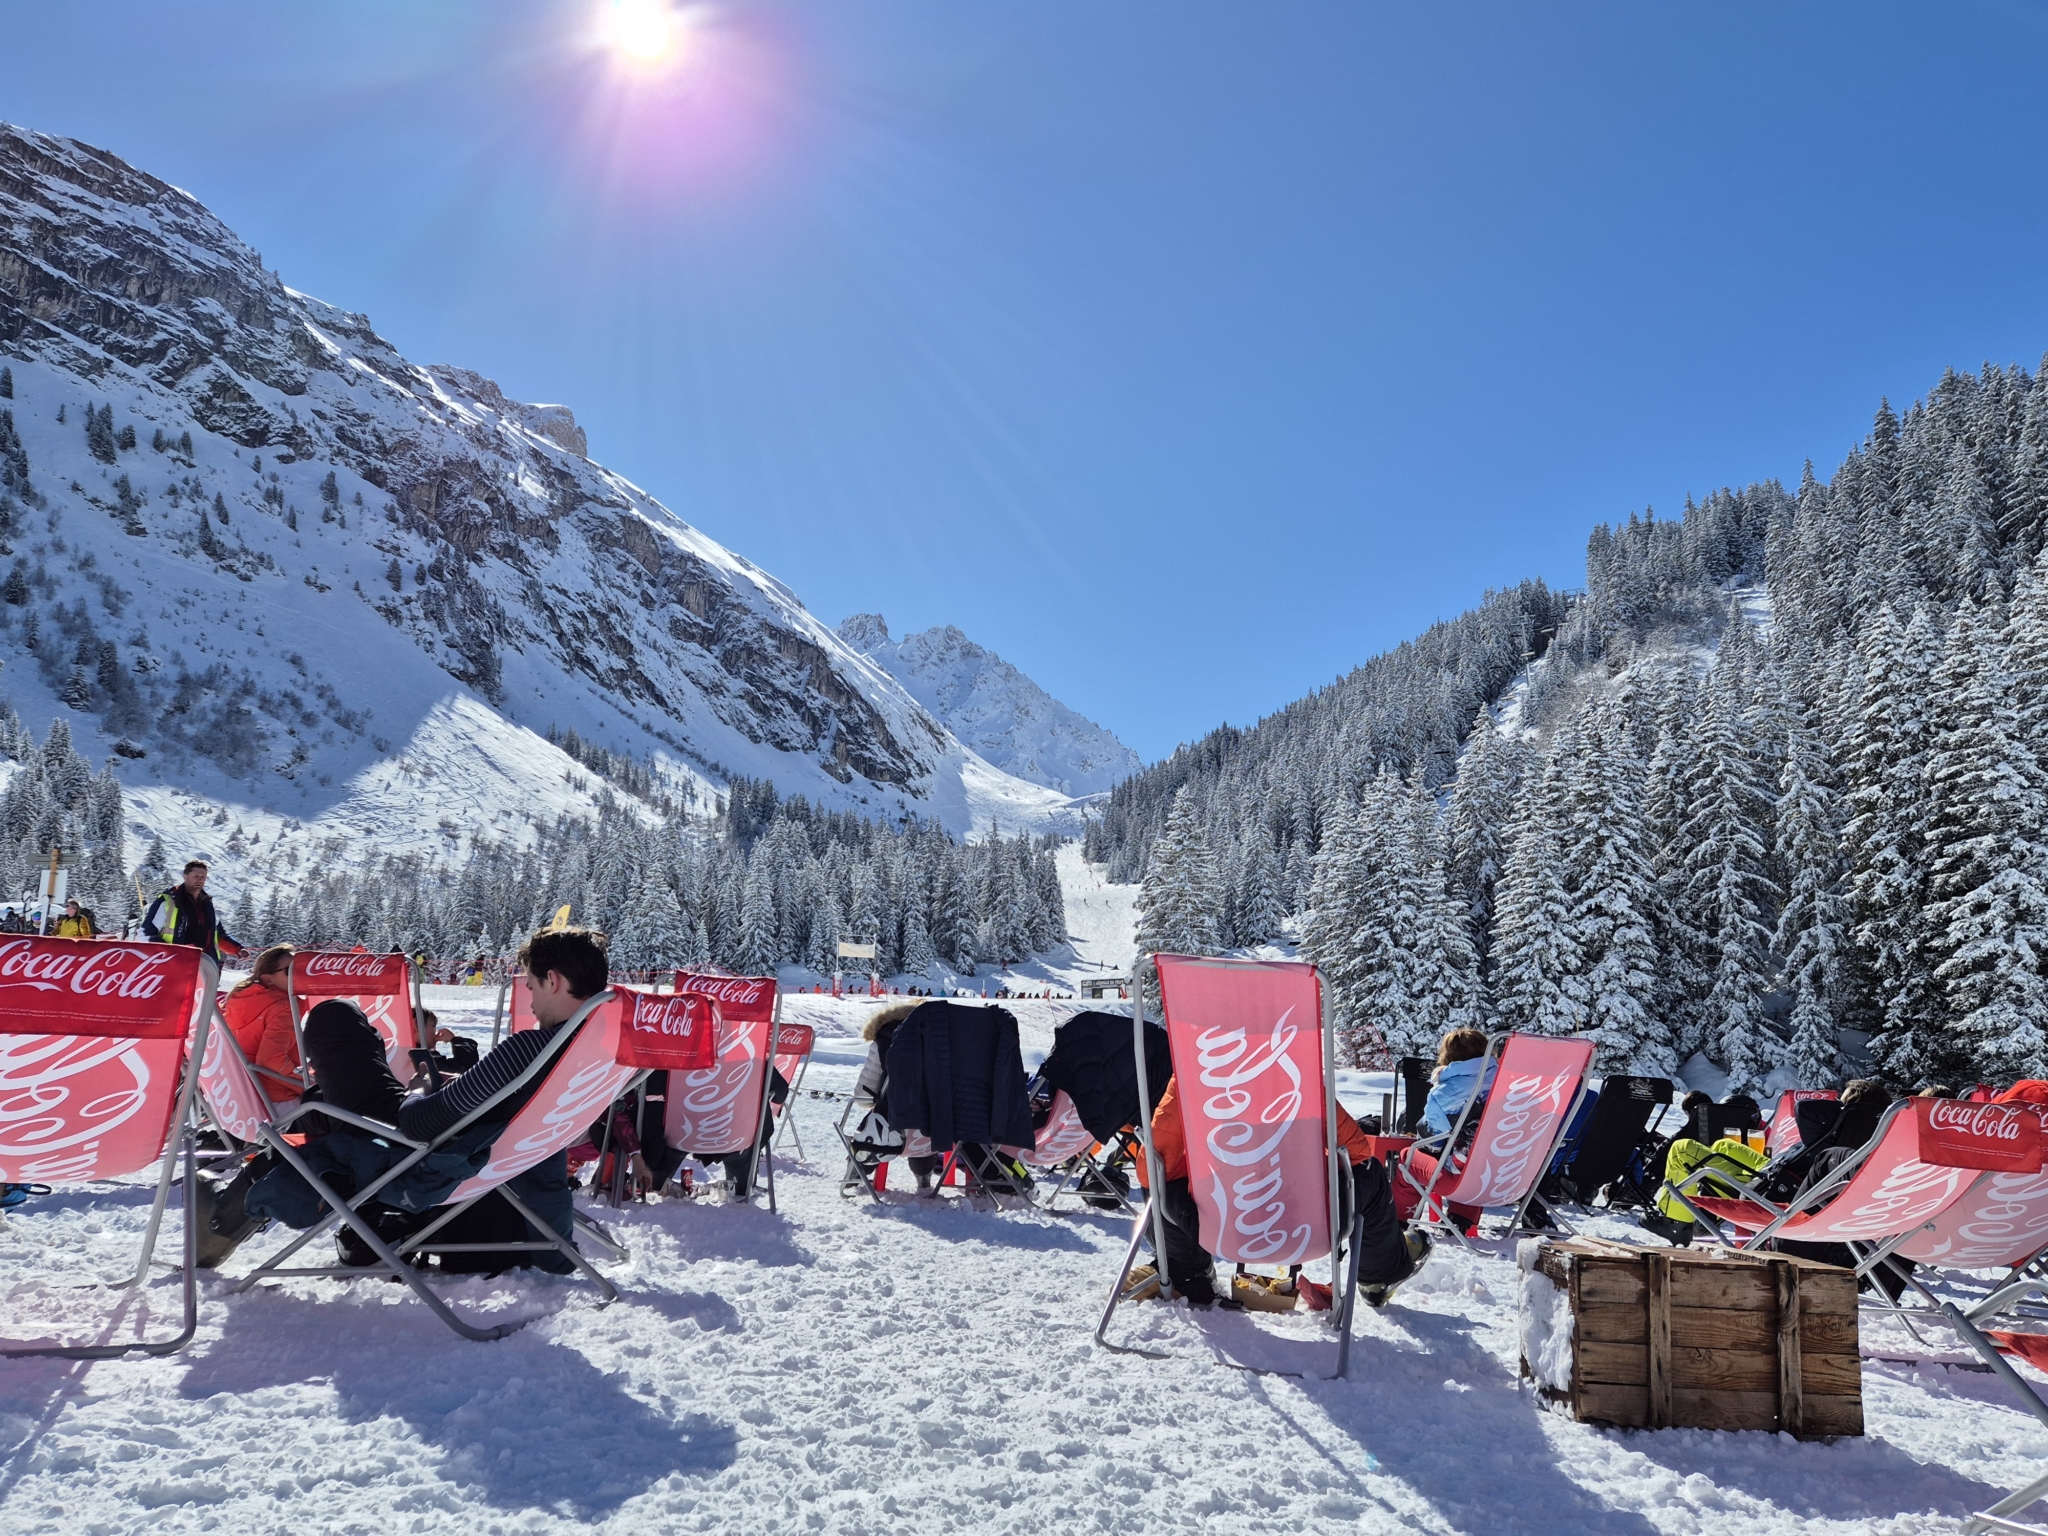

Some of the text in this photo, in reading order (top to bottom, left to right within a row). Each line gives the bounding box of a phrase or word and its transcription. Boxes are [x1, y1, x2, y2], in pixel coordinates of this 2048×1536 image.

[306, 953, 391, 976] Coca-Cola
[682, 975, 766, 1004] Coca-Cola
[1929, 1098, 2022, 1139] Coca-Cola
